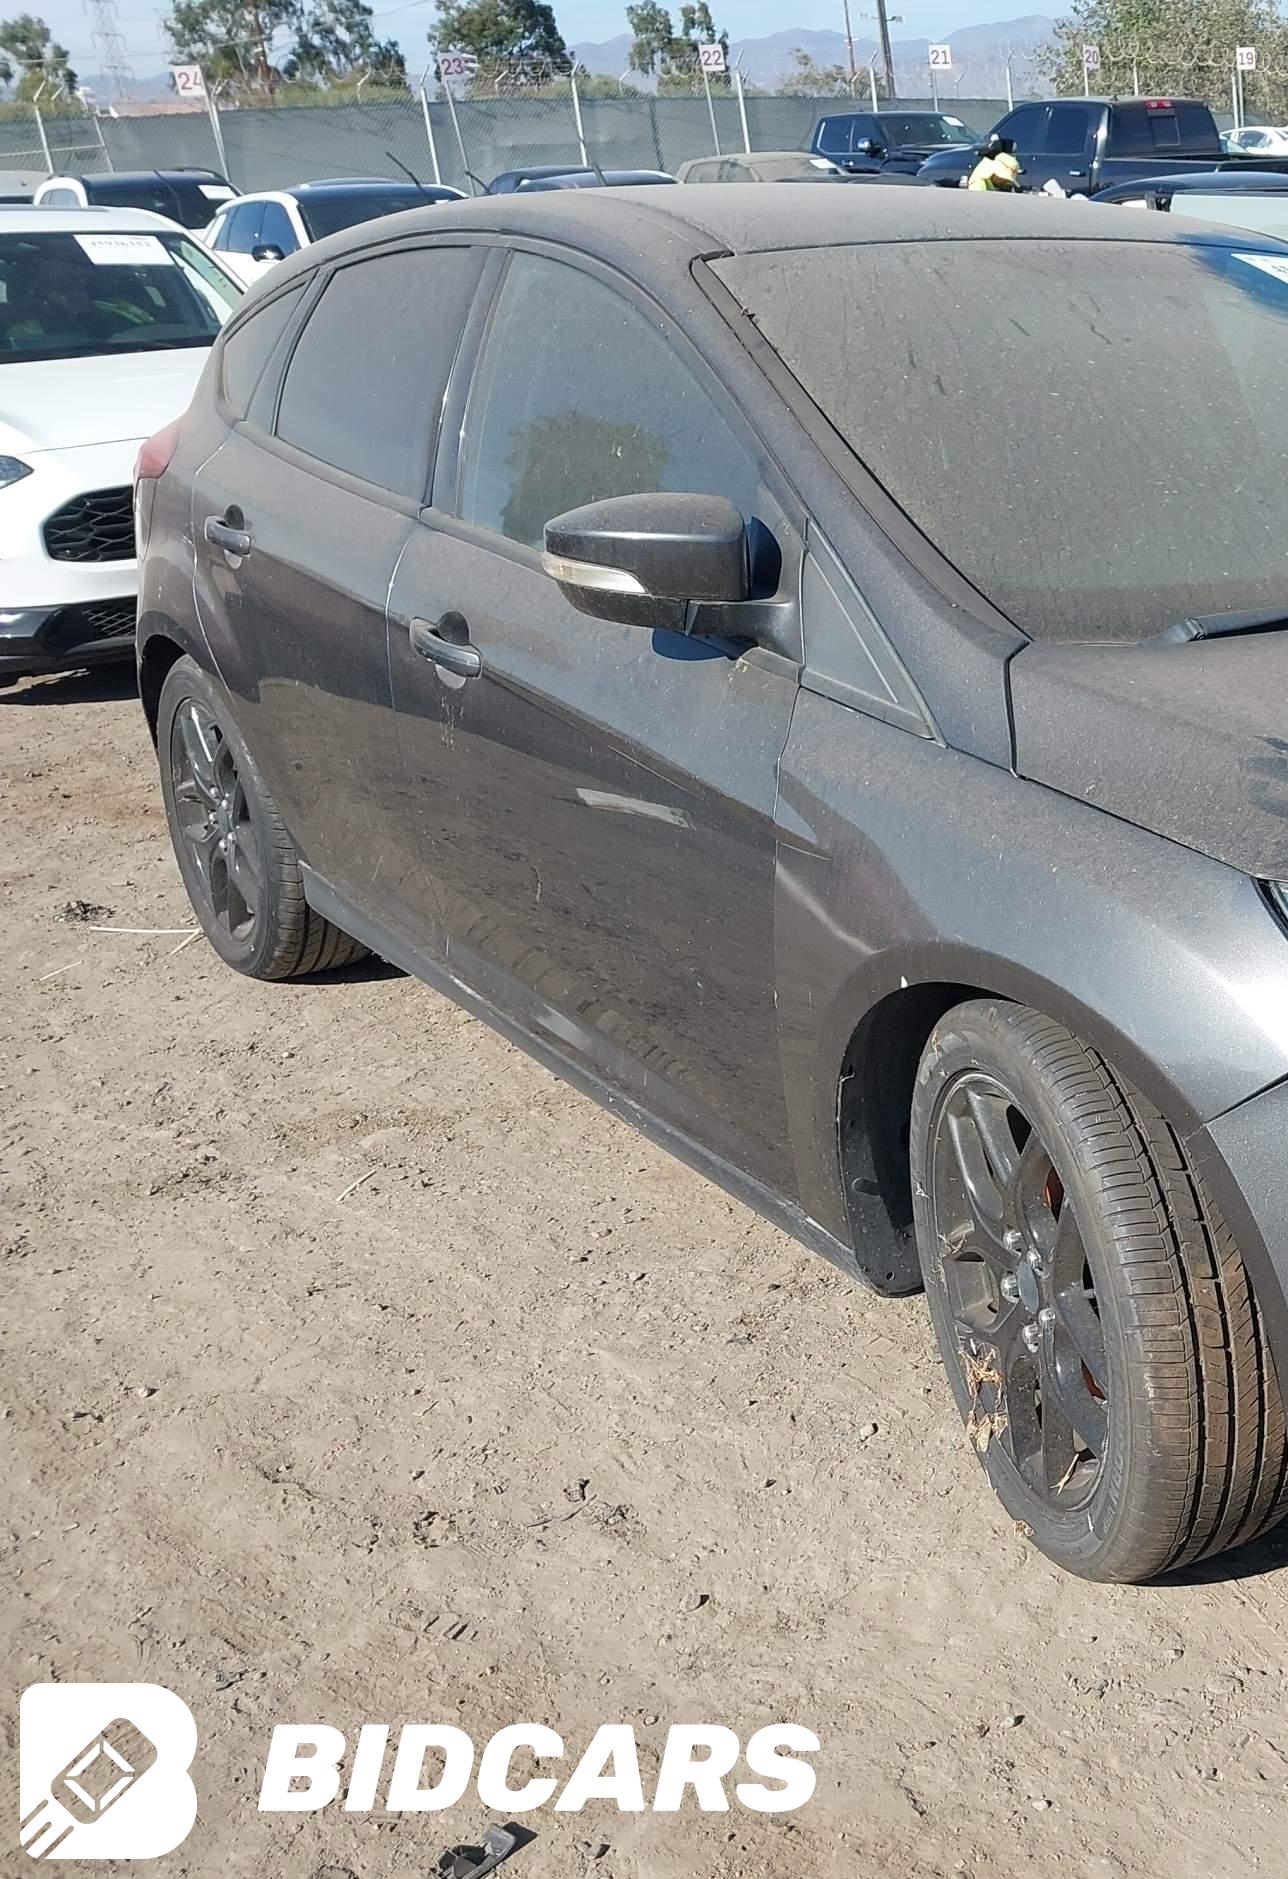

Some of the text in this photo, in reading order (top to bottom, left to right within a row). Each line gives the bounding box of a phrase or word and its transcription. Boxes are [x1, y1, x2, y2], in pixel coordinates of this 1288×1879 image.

[702, 50, 723, 66] 22
[931, 49, 950, 65] 21
[1085, 49, 1099, 65] 20
[1239, 51, 1254, 66] 19
[441, 57, 464, 75] 23
[178, 71, 203, 90] 24
